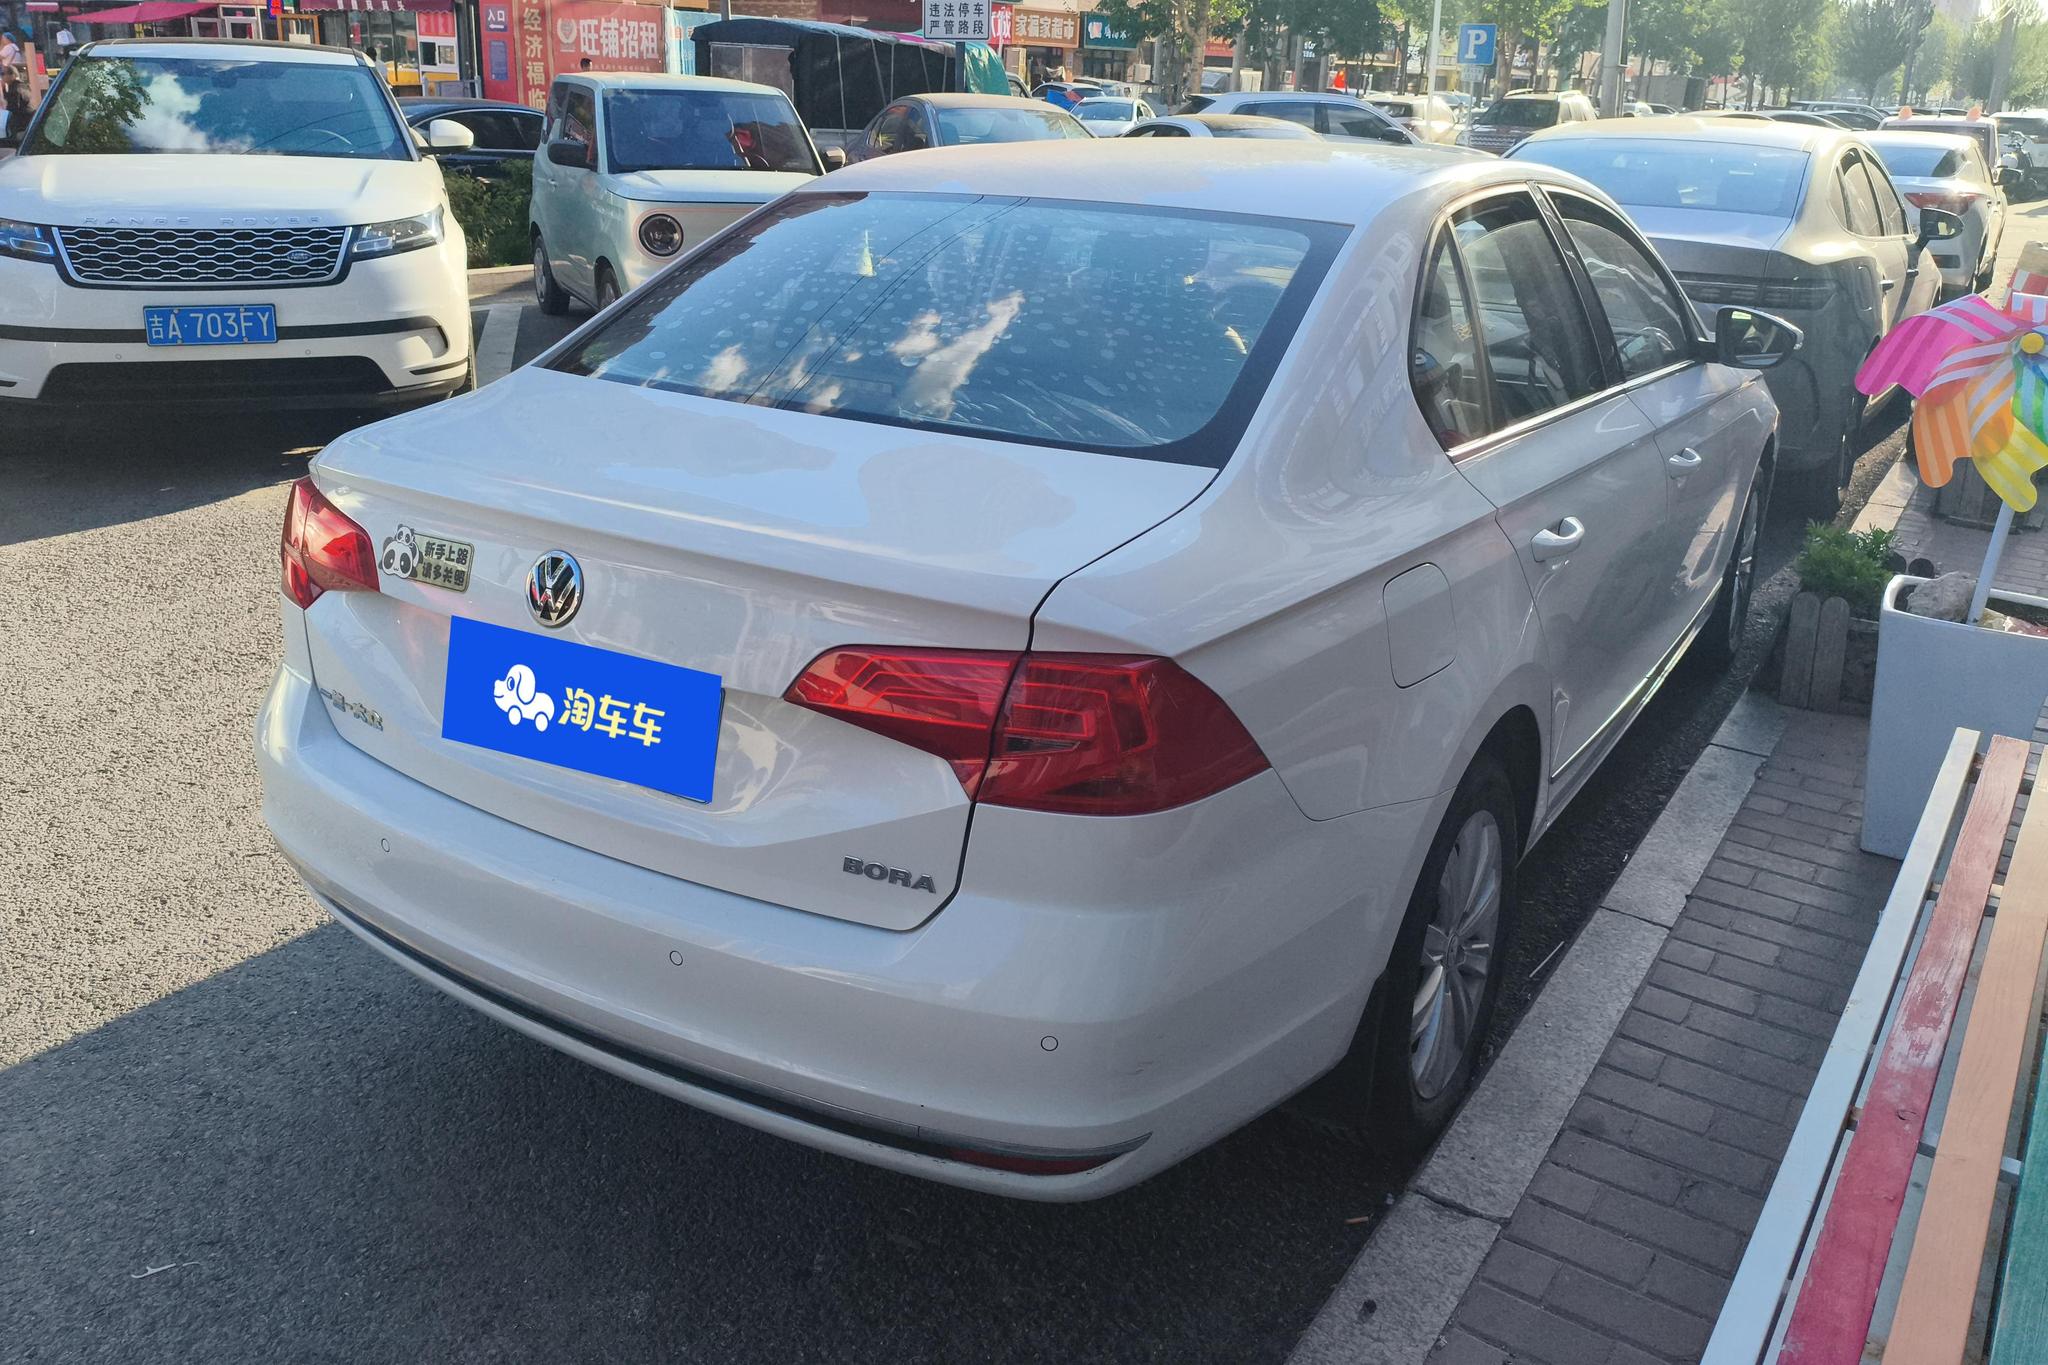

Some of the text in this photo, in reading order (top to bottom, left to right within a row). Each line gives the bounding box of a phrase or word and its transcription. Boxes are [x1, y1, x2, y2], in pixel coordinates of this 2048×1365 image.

[487, 9, 505, 21] 入口
[929, 2, 984, 17] 违法停车
[580, 18, 659, 59] 旺铺招租
[929, 20, 984, 34] 严管路段
[1464, 29, 1488, 59] P
[522, 0, 546, 113] 经济福临
[84, 216, 322, 226] RANGE ROVER
[424, 541, 468, 565] 新手上路
[422, 562, 465, 586] 请多关照
[843, 855, 936, 894] BORA
